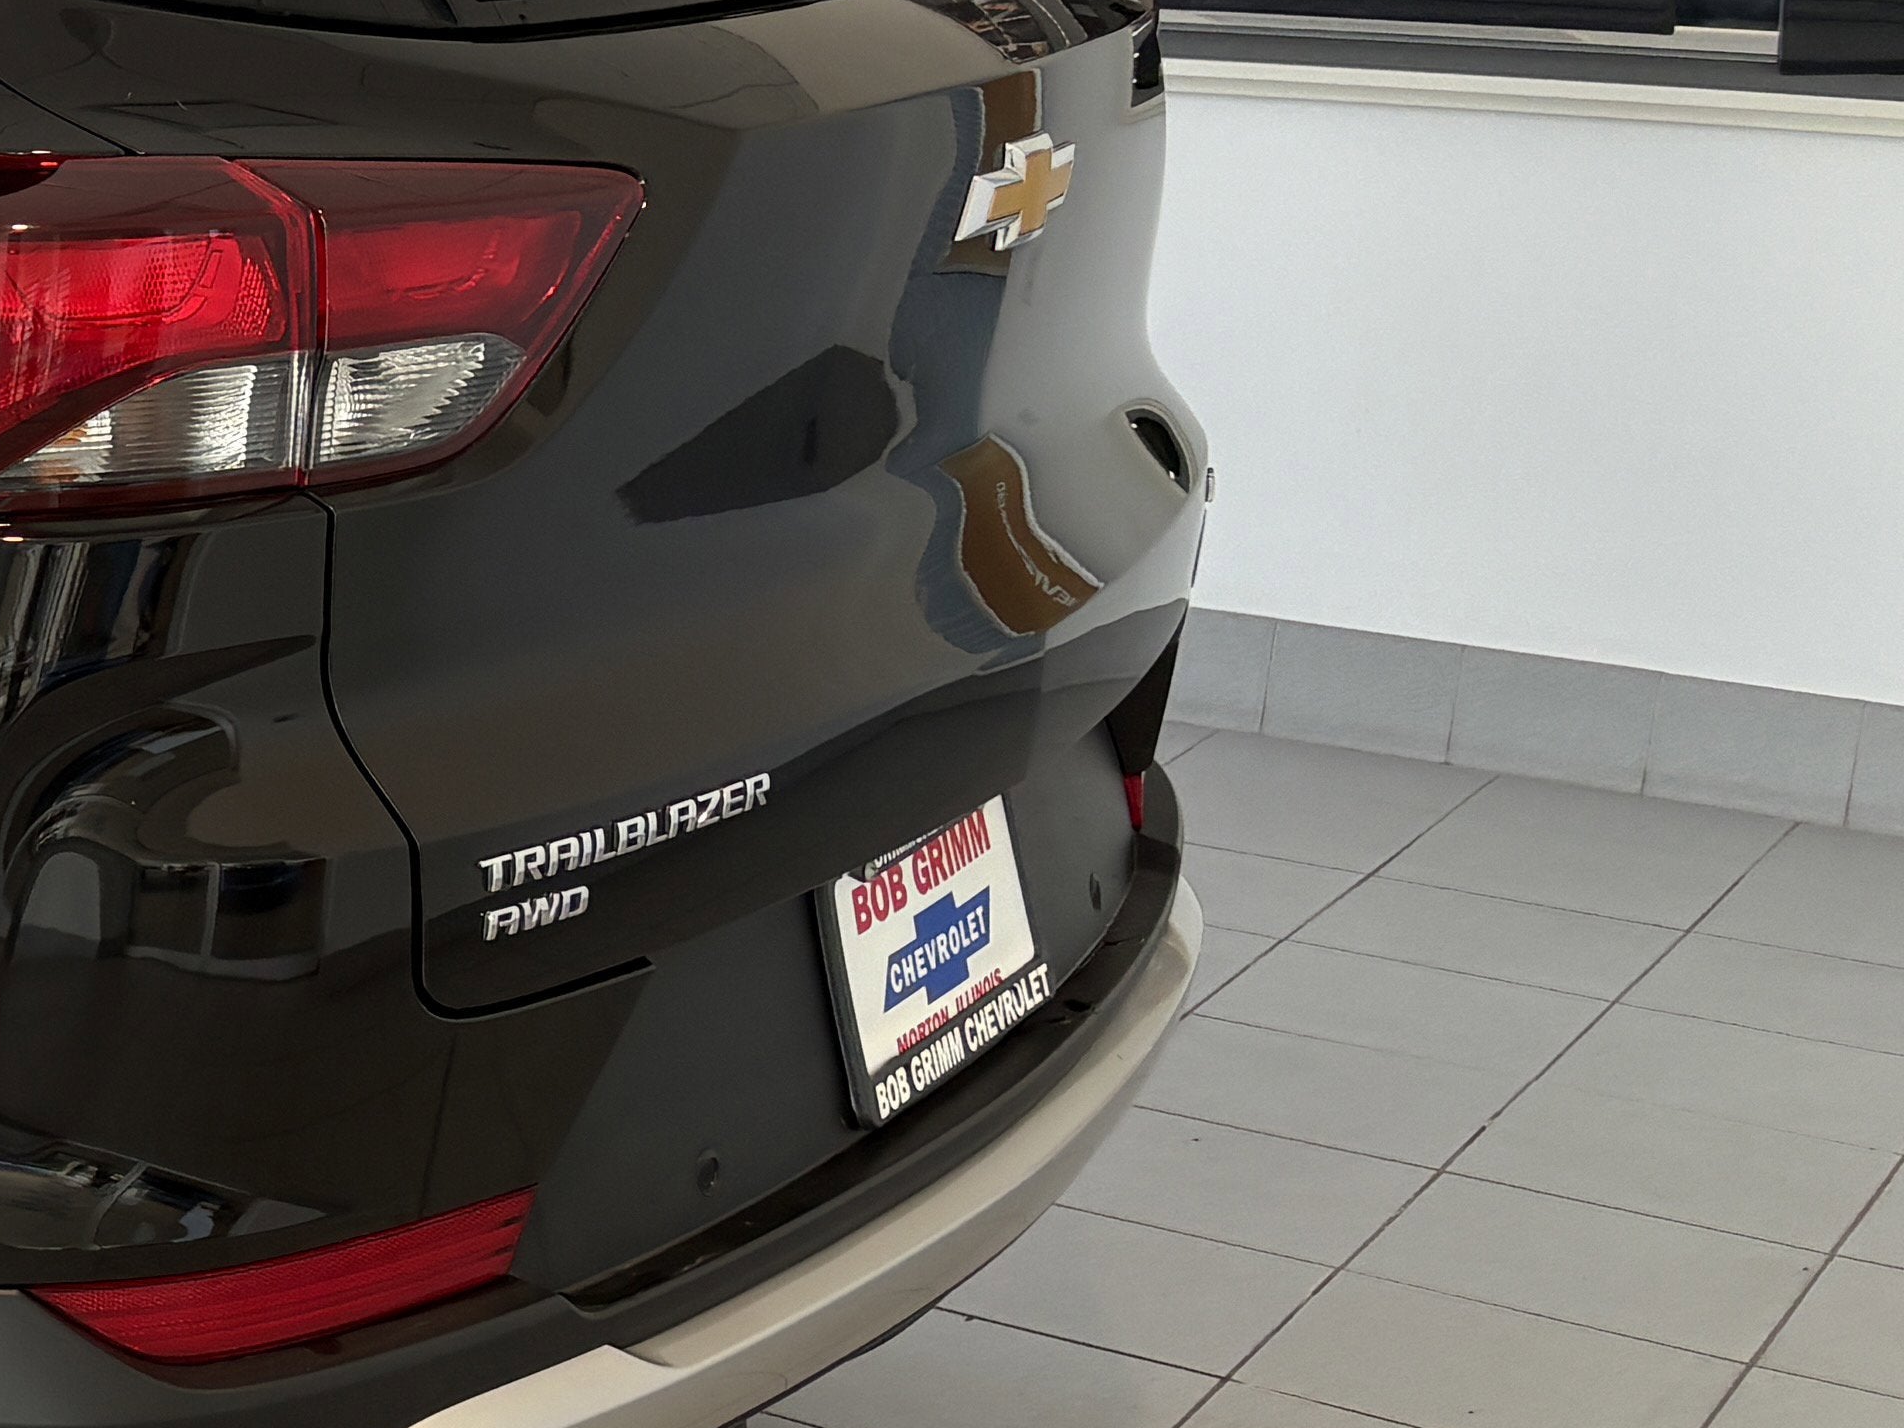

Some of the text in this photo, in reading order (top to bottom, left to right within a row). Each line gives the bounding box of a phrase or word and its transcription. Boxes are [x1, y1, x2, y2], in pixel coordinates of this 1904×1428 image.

[478, 772, 771, 893] TRAILBLAZER
[851, 862, 908, 935] BOB
[912, 808, 991, 895] GRIMM
[481, 885, 590, 942] AWD
[891, 905, 987, 993] CHEVROLET
[875, 963, 1051, 1120] BOB GRIMM CHEVROLET
[896, 967, 1005, 1055] MORTON ILLINOIS
